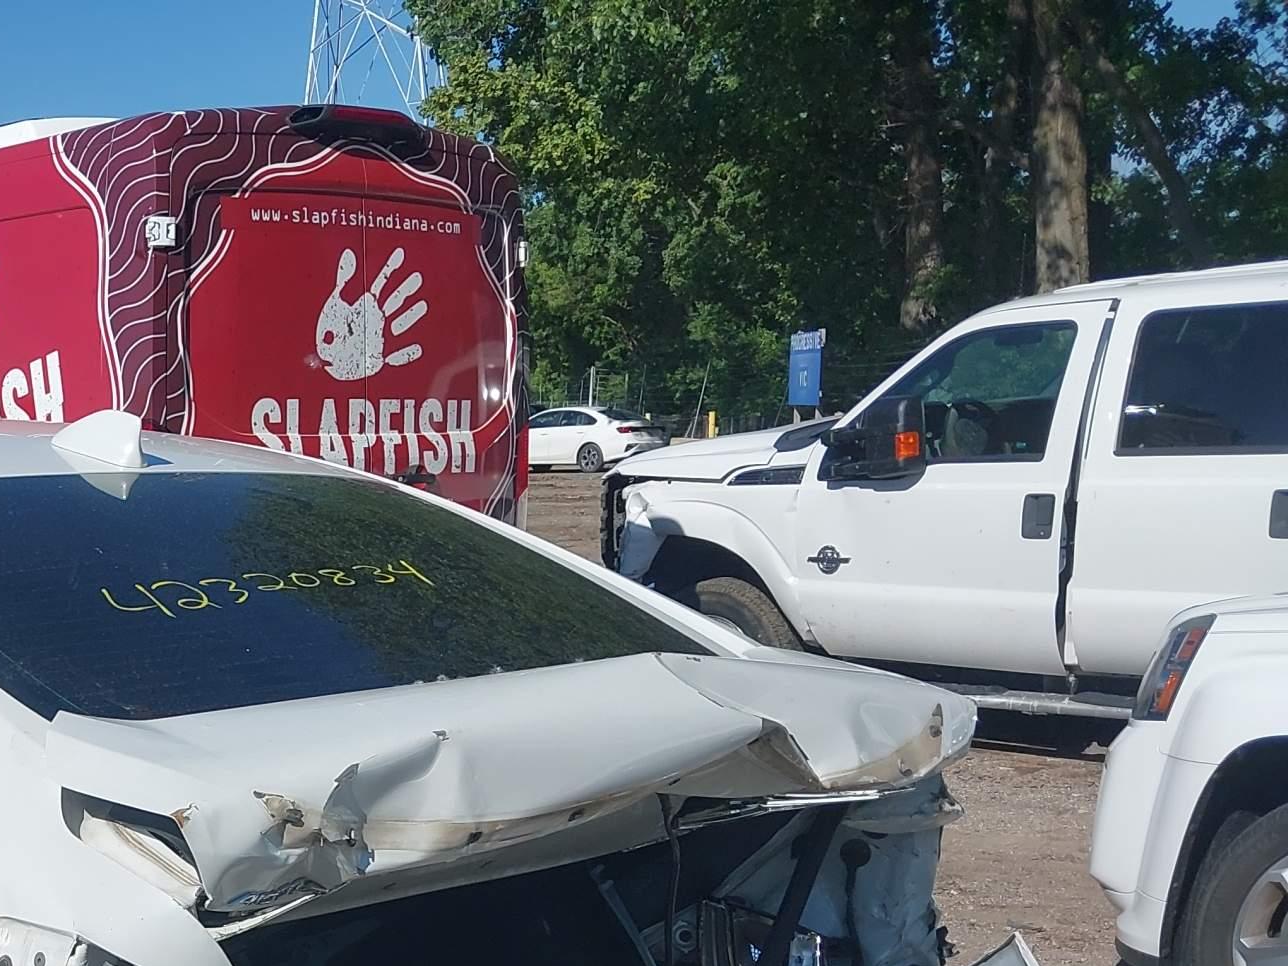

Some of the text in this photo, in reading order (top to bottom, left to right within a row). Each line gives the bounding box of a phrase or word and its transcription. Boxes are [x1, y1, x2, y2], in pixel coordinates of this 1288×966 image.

[251, 207, 461, 234] www.slapfishindiana.com
[252, 398, 476, 475] SLAPFISH
[101, 560, 435, 618] 42320834
